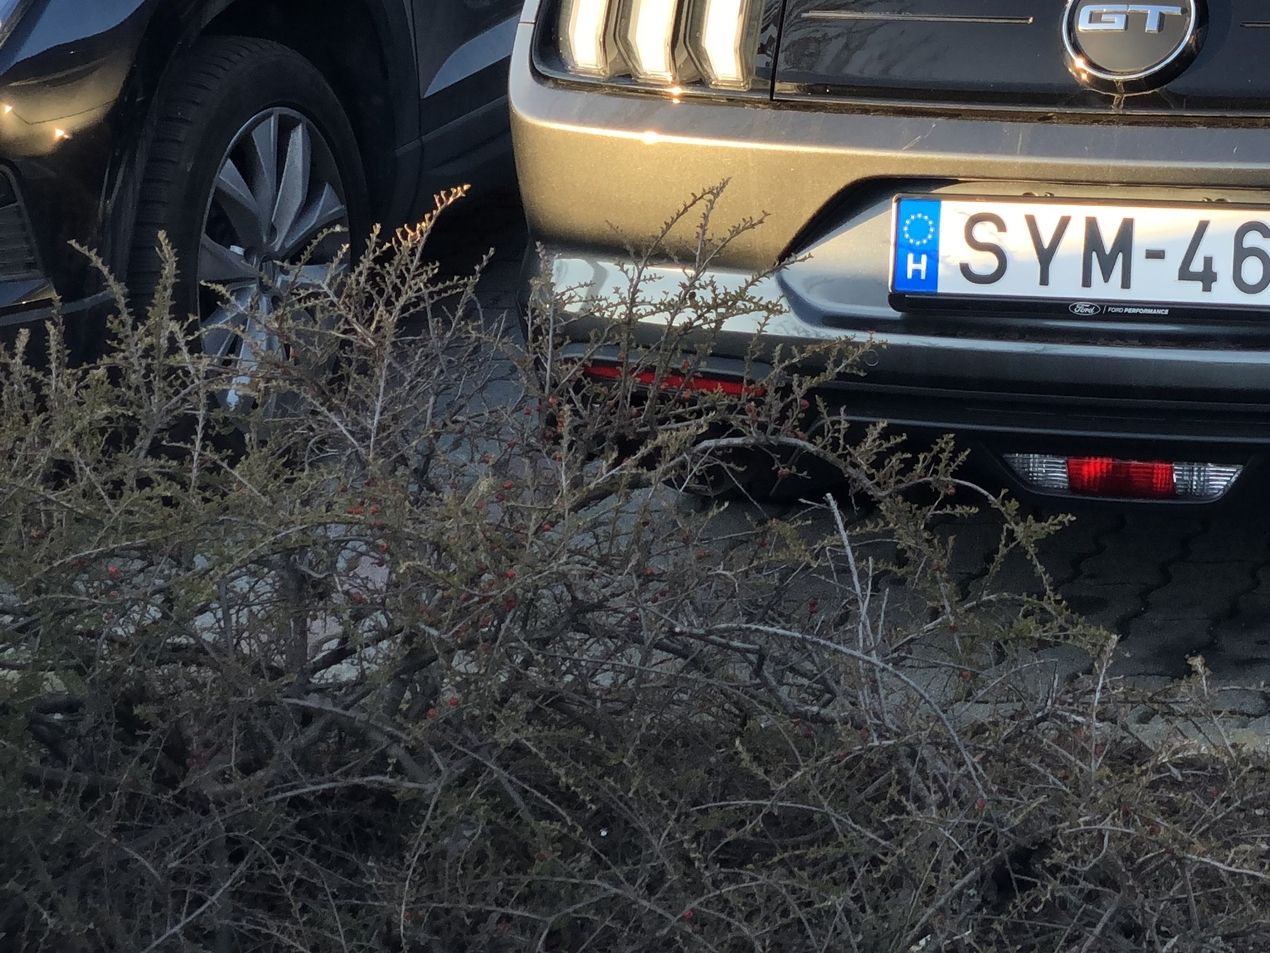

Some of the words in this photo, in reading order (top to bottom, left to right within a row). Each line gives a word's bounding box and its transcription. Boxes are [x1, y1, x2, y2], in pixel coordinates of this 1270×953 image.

[1077, 4, 1183, 34] GT
[906, 253, 926, 280] H
[1073, 303, 1096, 314] Ford
[1124, 307, 1169, 315] PERFORMANCE
